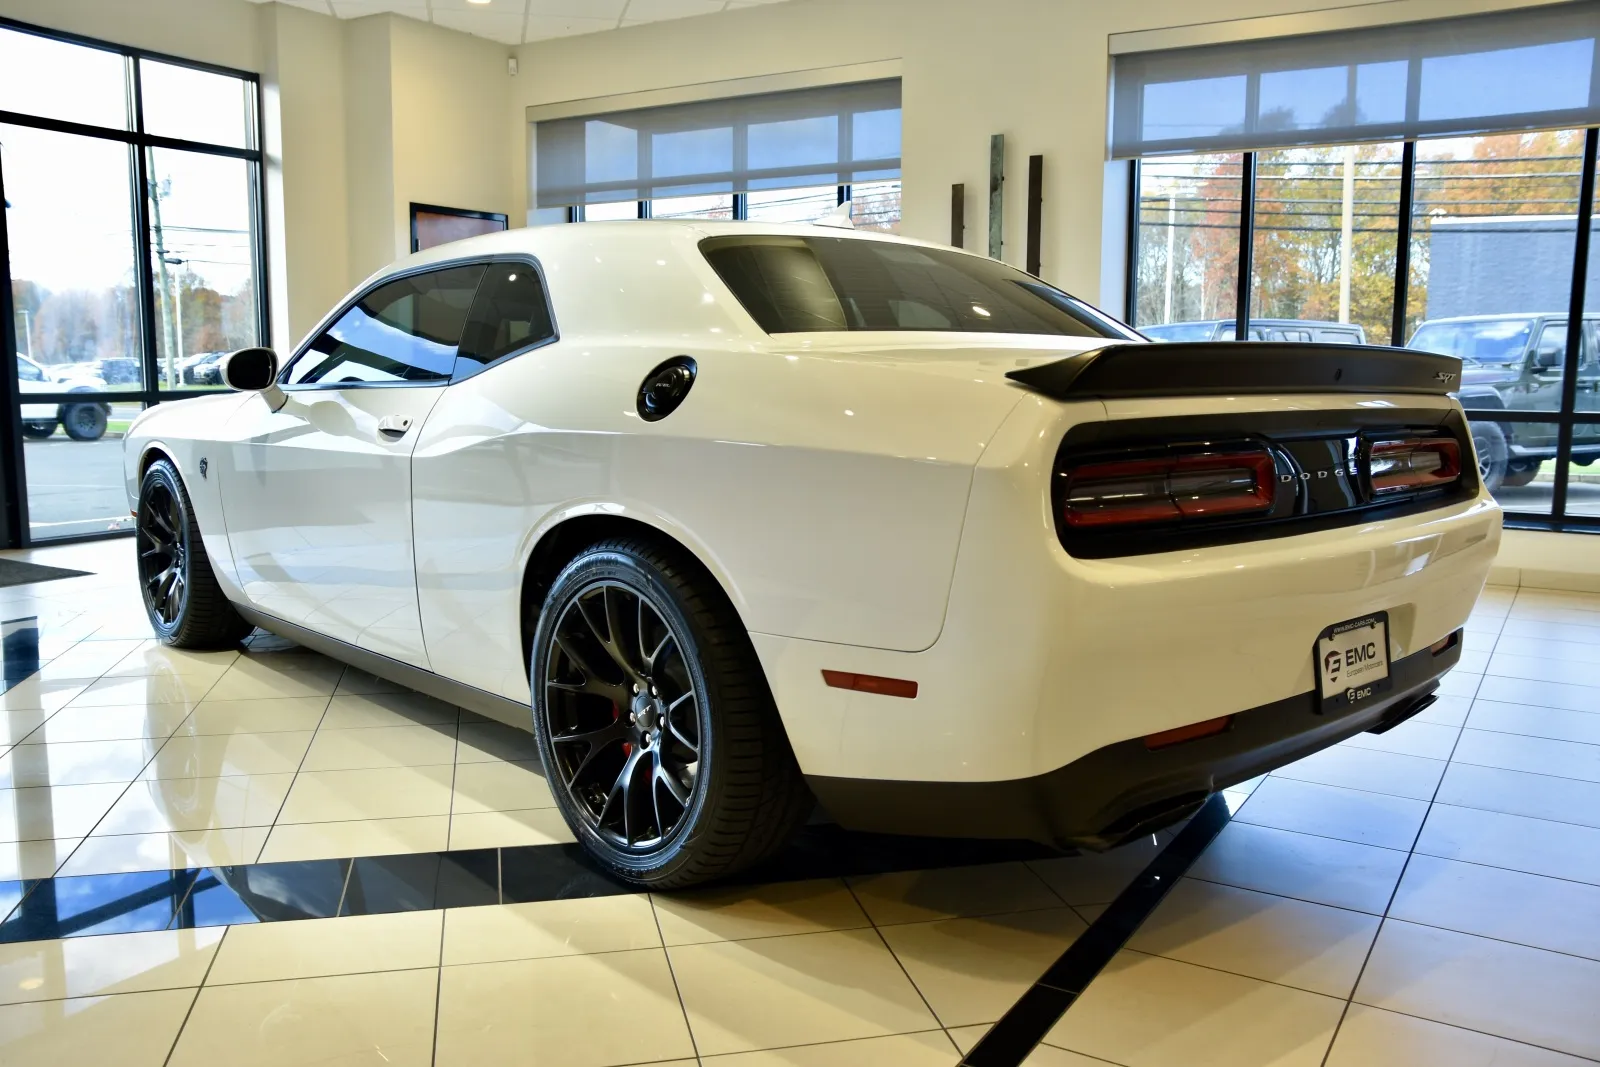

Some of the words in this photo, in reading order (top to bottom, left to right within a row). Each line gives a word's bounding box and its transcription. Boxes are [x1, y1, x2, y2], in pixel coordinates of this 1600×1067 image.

[1434, 372, 1457, 384] SRT
[1280, 467, 1357, 483] DODGE
[1345, 642, 1376, 667] EMC
[1356, 687, 1372, 700] EMC
